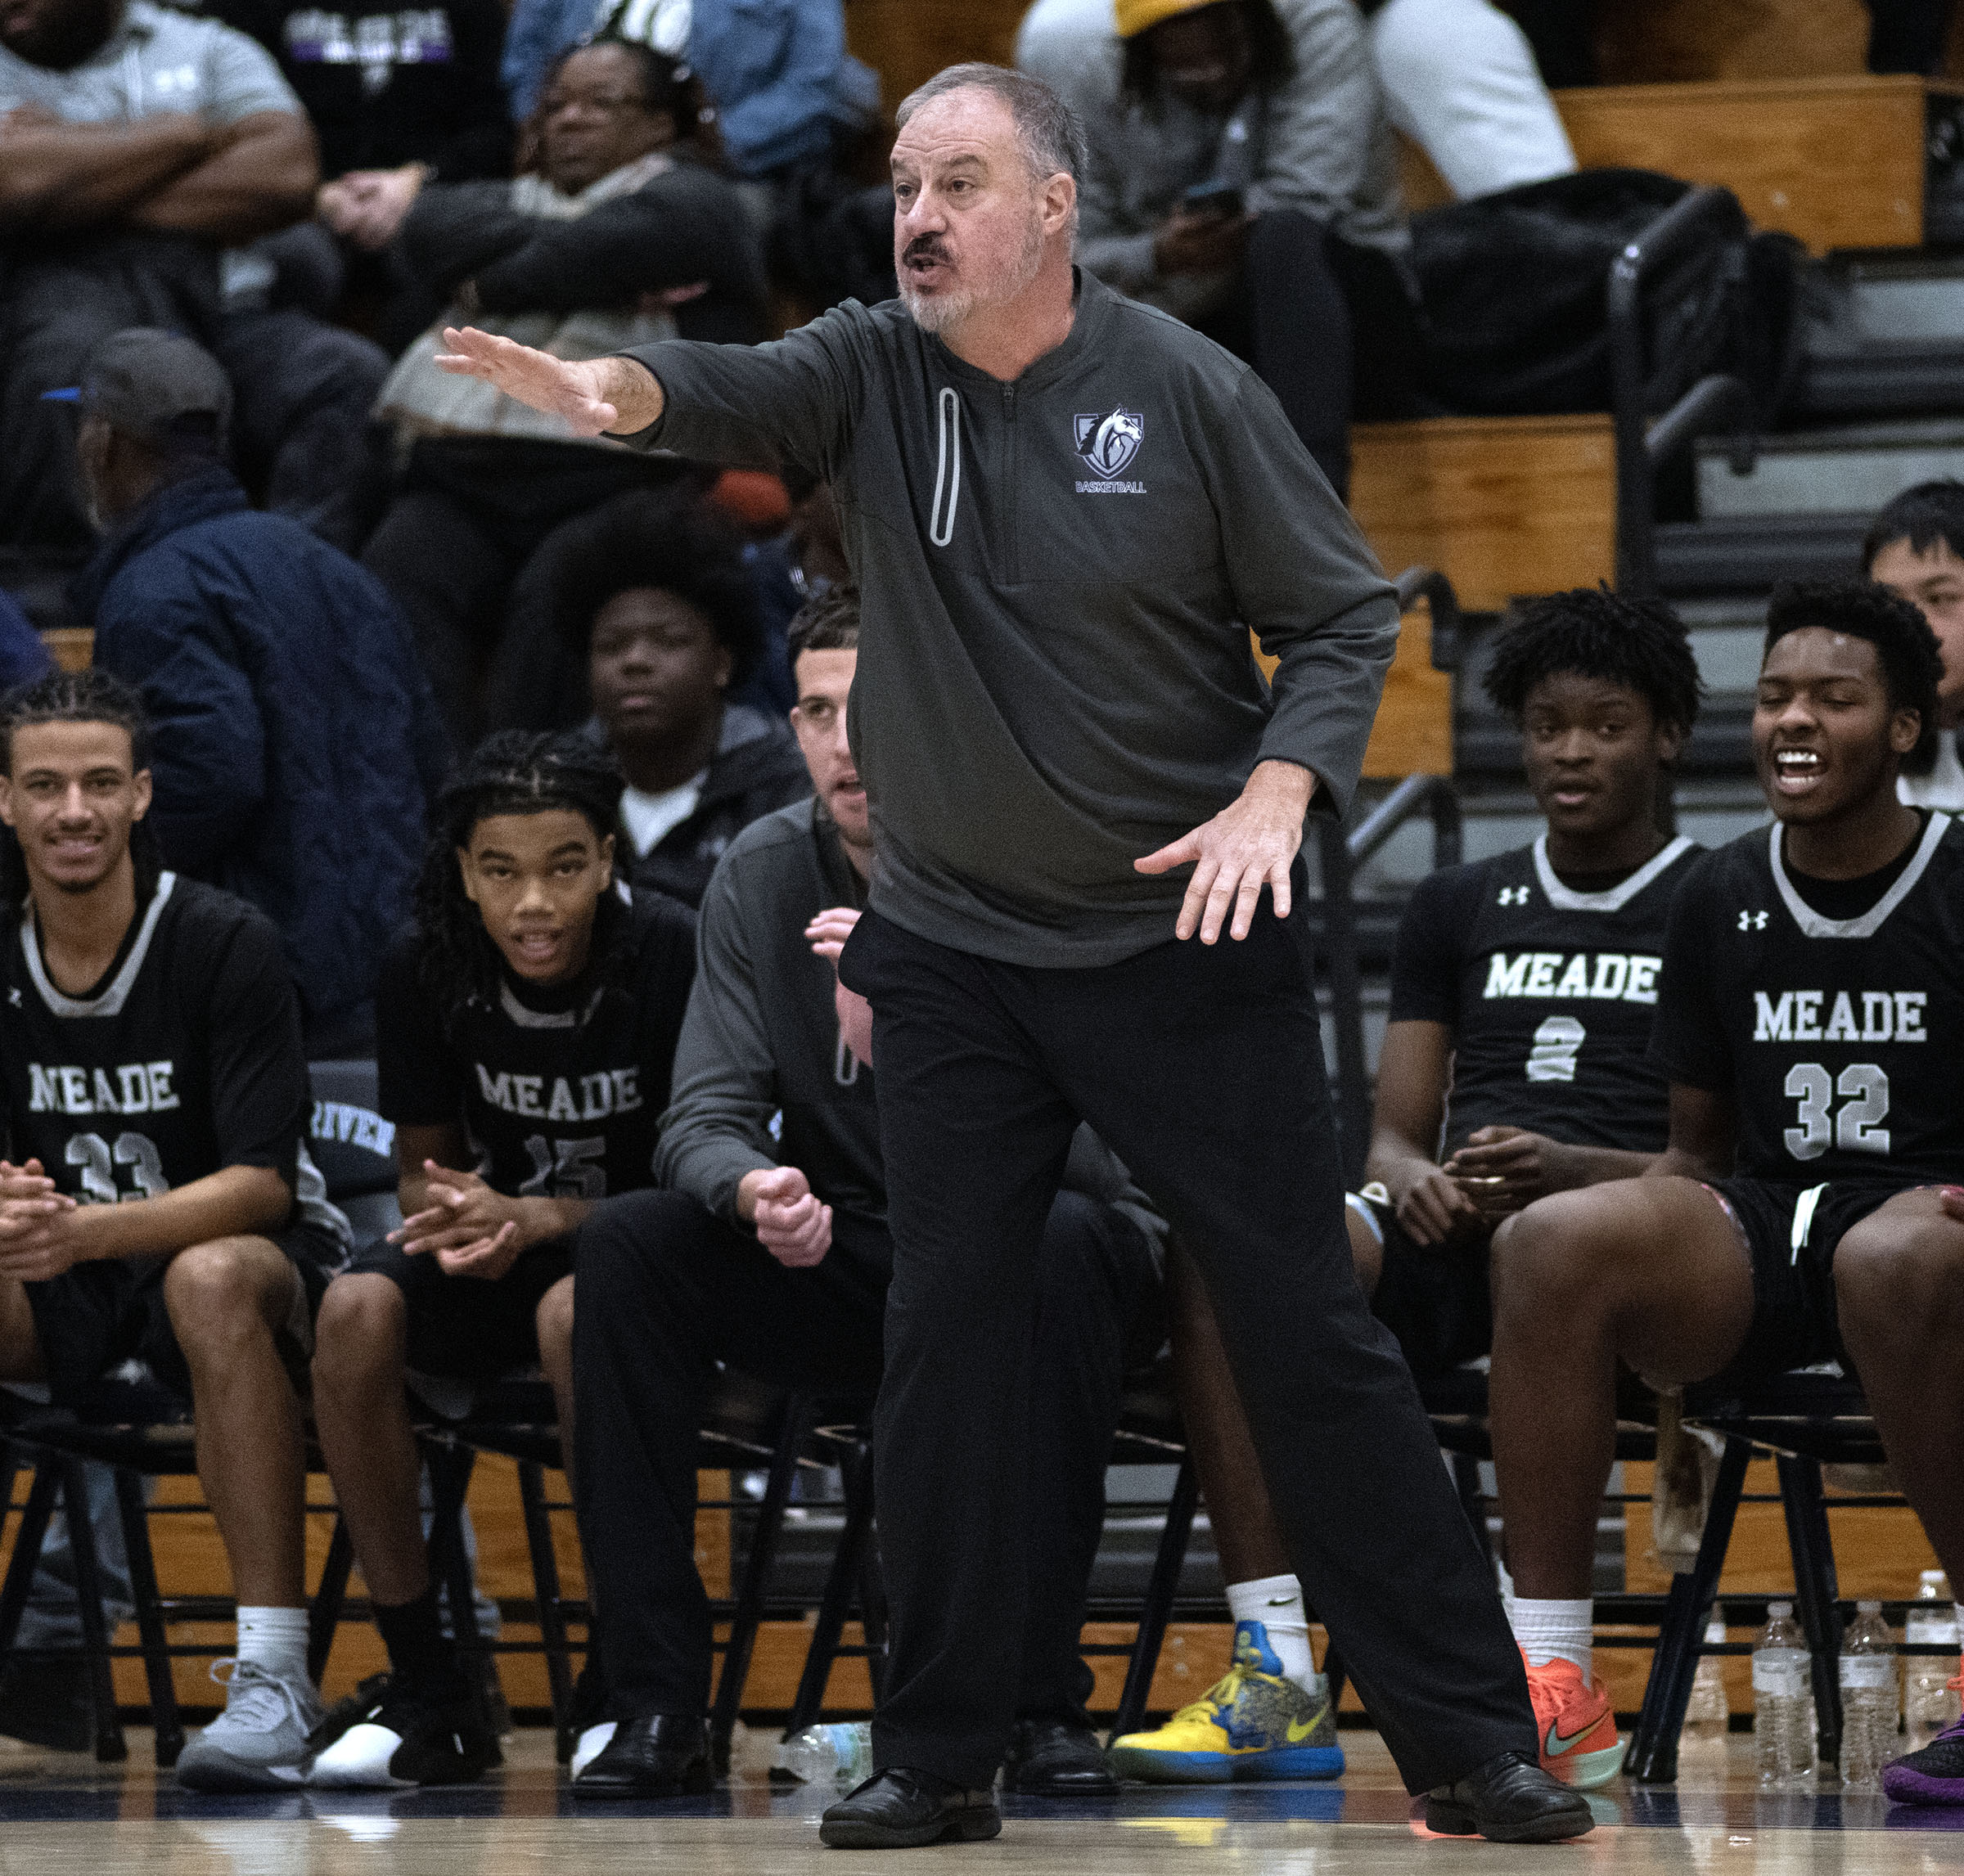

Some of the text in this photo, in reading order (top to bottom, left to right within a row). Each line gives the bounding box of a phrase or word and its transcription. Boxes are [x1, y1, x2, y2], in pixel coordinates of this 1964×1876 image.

[1075, 481, 1146, 493] BASKETBALL
[1483, 952, 1663, 1004] MEADE
[1753, 990, 1927, 1041] MEADE
[1525, 1015, 1586, 1082] 2
[475, 1063, 644, 1122] MEADE
[1783, 1063, 1890, 1160] 32
[65, 1131, 169, 1206] 33
